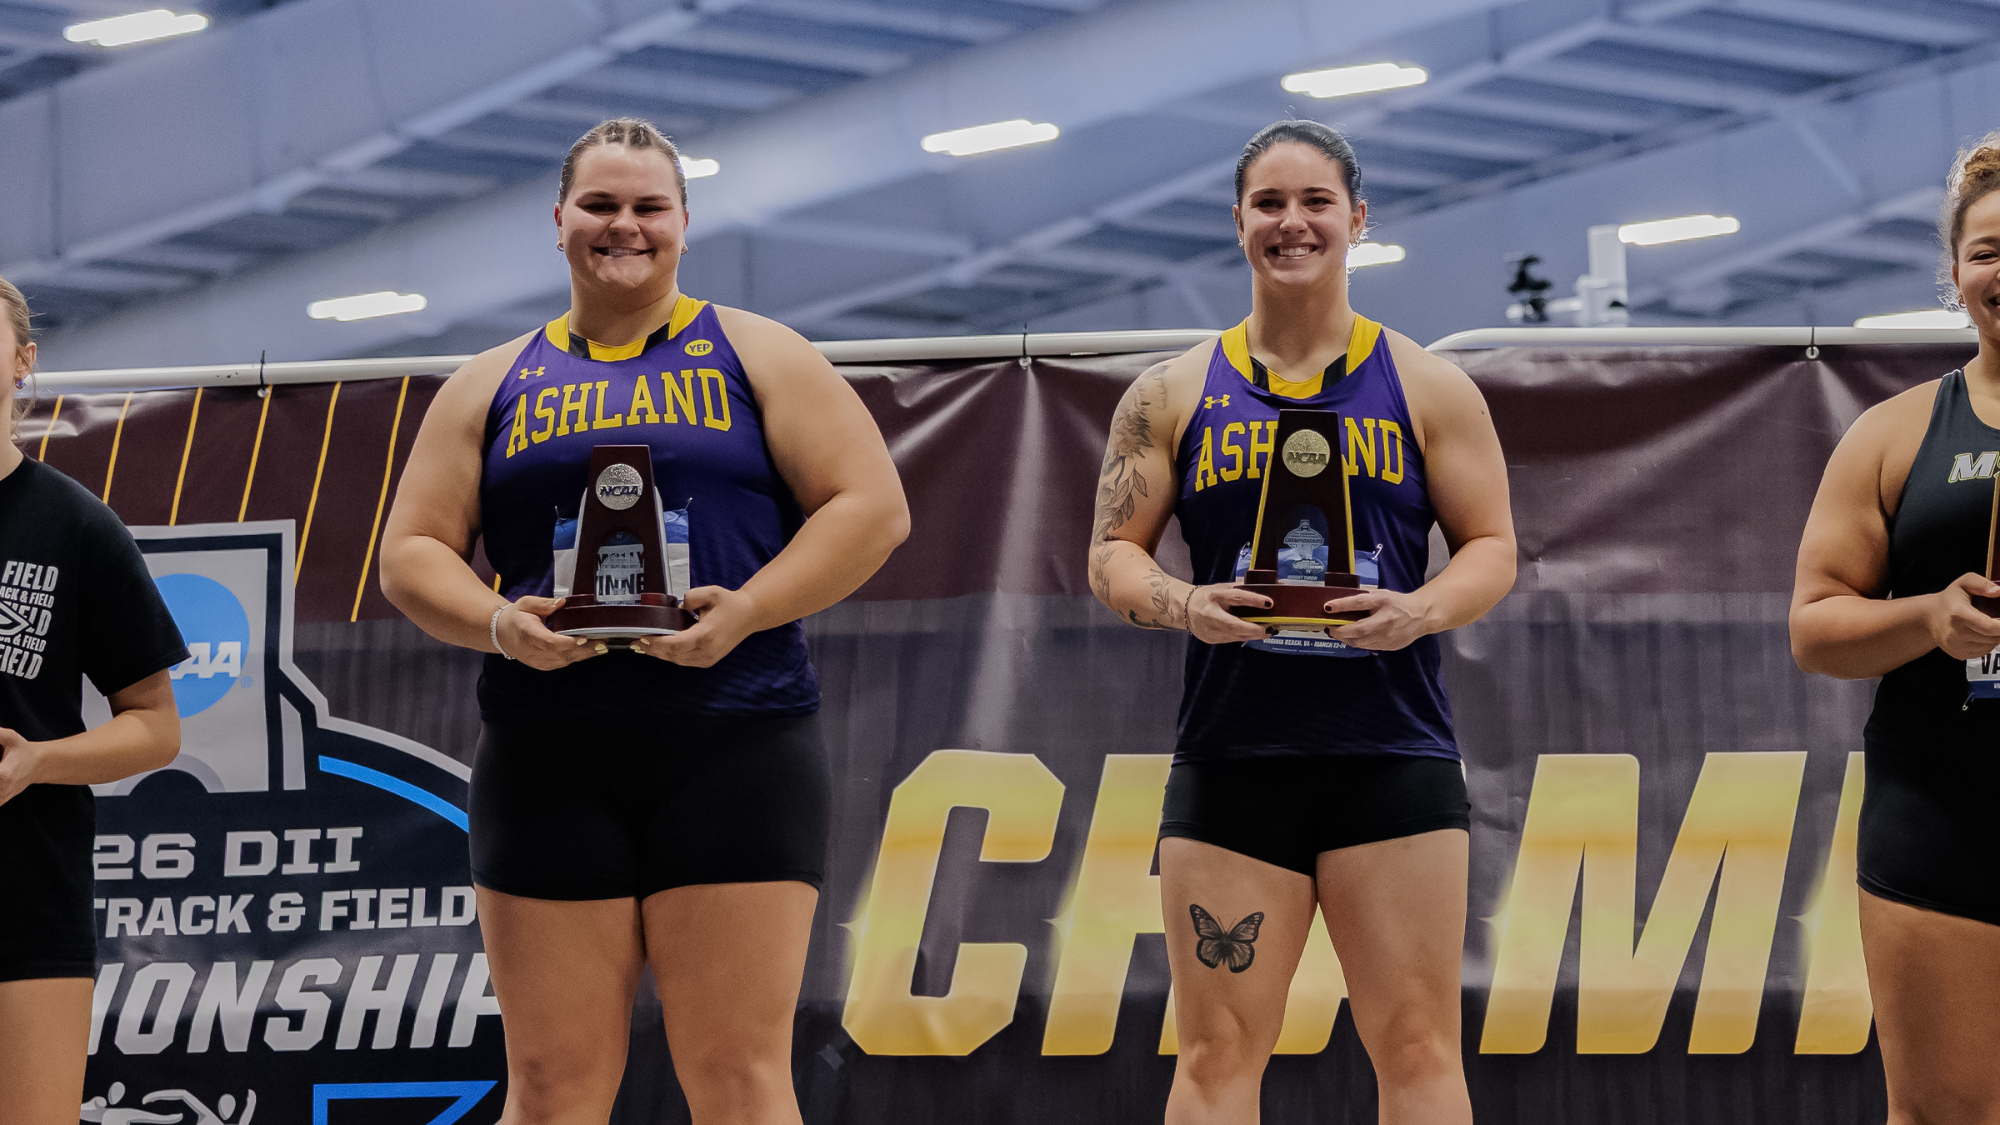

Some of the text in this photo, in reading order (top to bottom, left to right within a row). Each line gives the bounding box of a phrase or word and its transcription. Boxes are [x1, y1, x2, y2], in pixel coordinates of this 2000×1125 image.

[689, 343, 710, 353] YEP
[506, 368, 732, 459] ASHLAND
[1195, 417, 1404, 492] ASHND
[1286, 451, 1328, 465] NCAA
[1948, 451, 2000, 483] M
[600, 484, 639, 497] NCAA
[1, 560, 59, 592] FIELD
[20, 590, 28, 604] &
[29, 592, 55, 608] FIELD
[22, 635, 47, 653] FIELD
[224, 826, 363, 877] DII
[267, 892, 306, 931] &
[319, 886, 477, 931] FIELD
